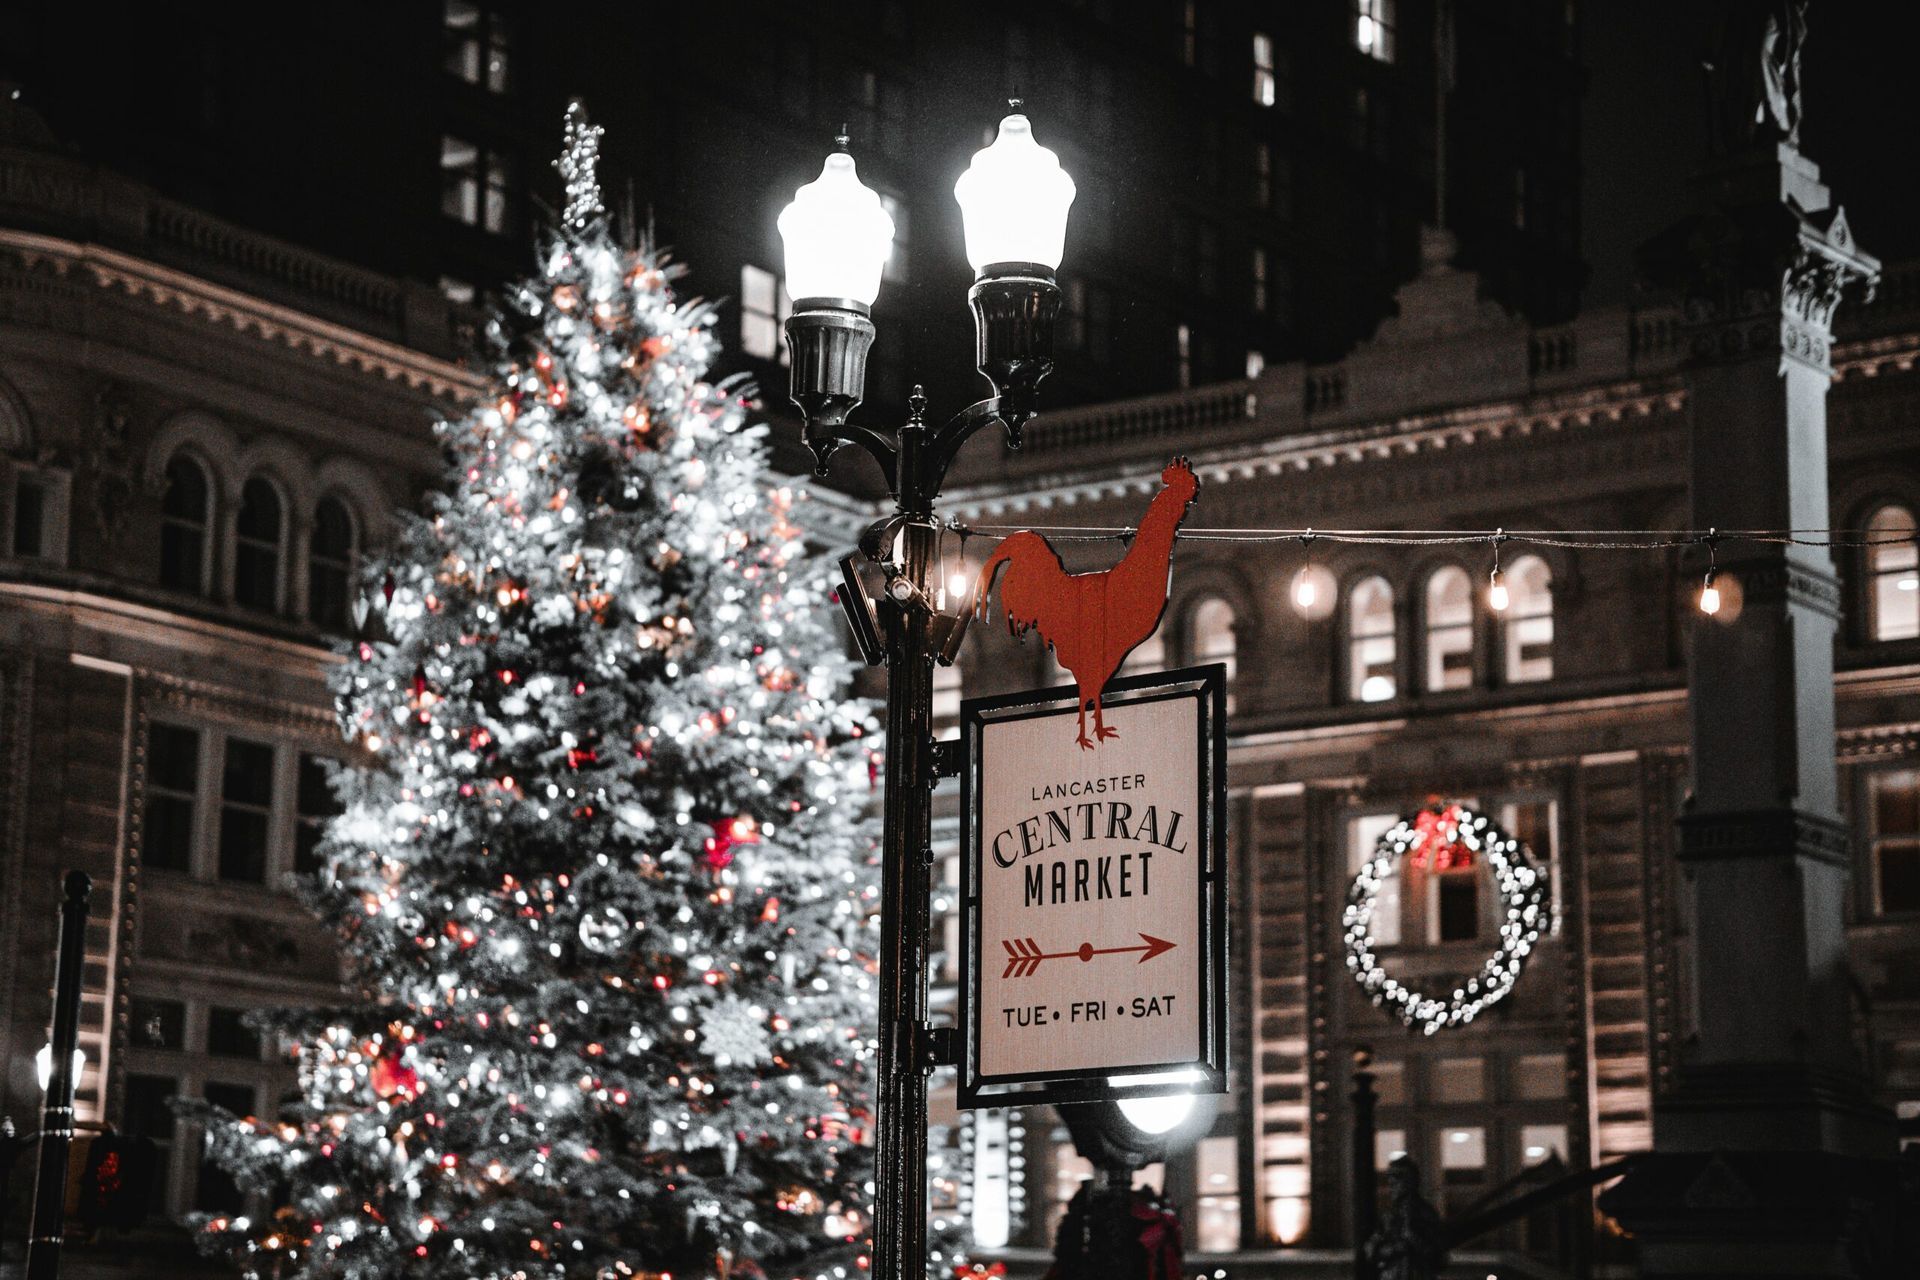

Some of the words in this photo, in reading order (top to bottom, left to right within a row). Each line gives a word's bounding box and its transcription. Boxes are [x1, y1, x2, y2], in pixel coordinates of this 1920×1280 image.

[1031, 774, 1146, 801] LANCASTER
[991, 801, 1188, 869] CENTRAL
[1024, 851, 1153, 908] MARKET
[1003, 1005, 1048, 1028] TUE
[1071, 1000, 1106, 1023] FRI
[1131, 995, 1176, 1019] SAT
